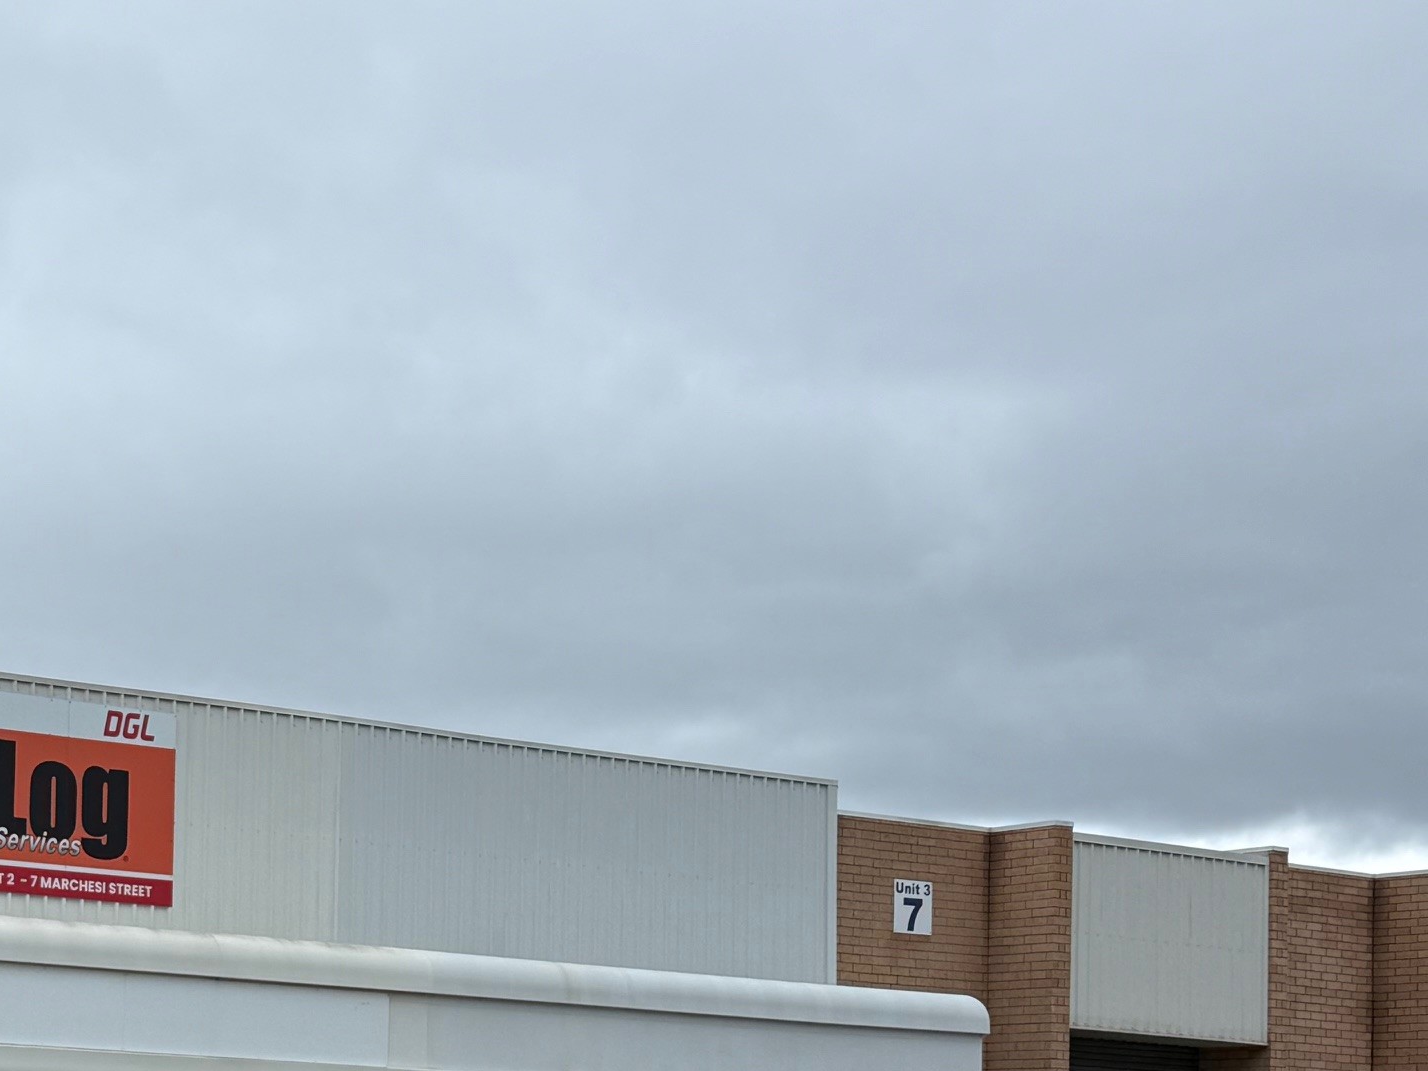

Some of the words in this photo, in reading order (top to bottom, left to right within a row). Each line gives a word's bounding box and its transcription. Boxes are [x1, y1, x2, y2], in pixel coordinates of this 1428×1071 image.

[104, 710, 155, 742] DGL
[7, 872, 15, 885] 2
[30, 875, 38, 888] 7
[40, 876, 106, 894] MARCHESI
[109, 884, 153, 898] STREET
[896, 881, 920, 895] Unit
[924, 884, 931, 896] 3
[903, 897, 923, 932] 7
